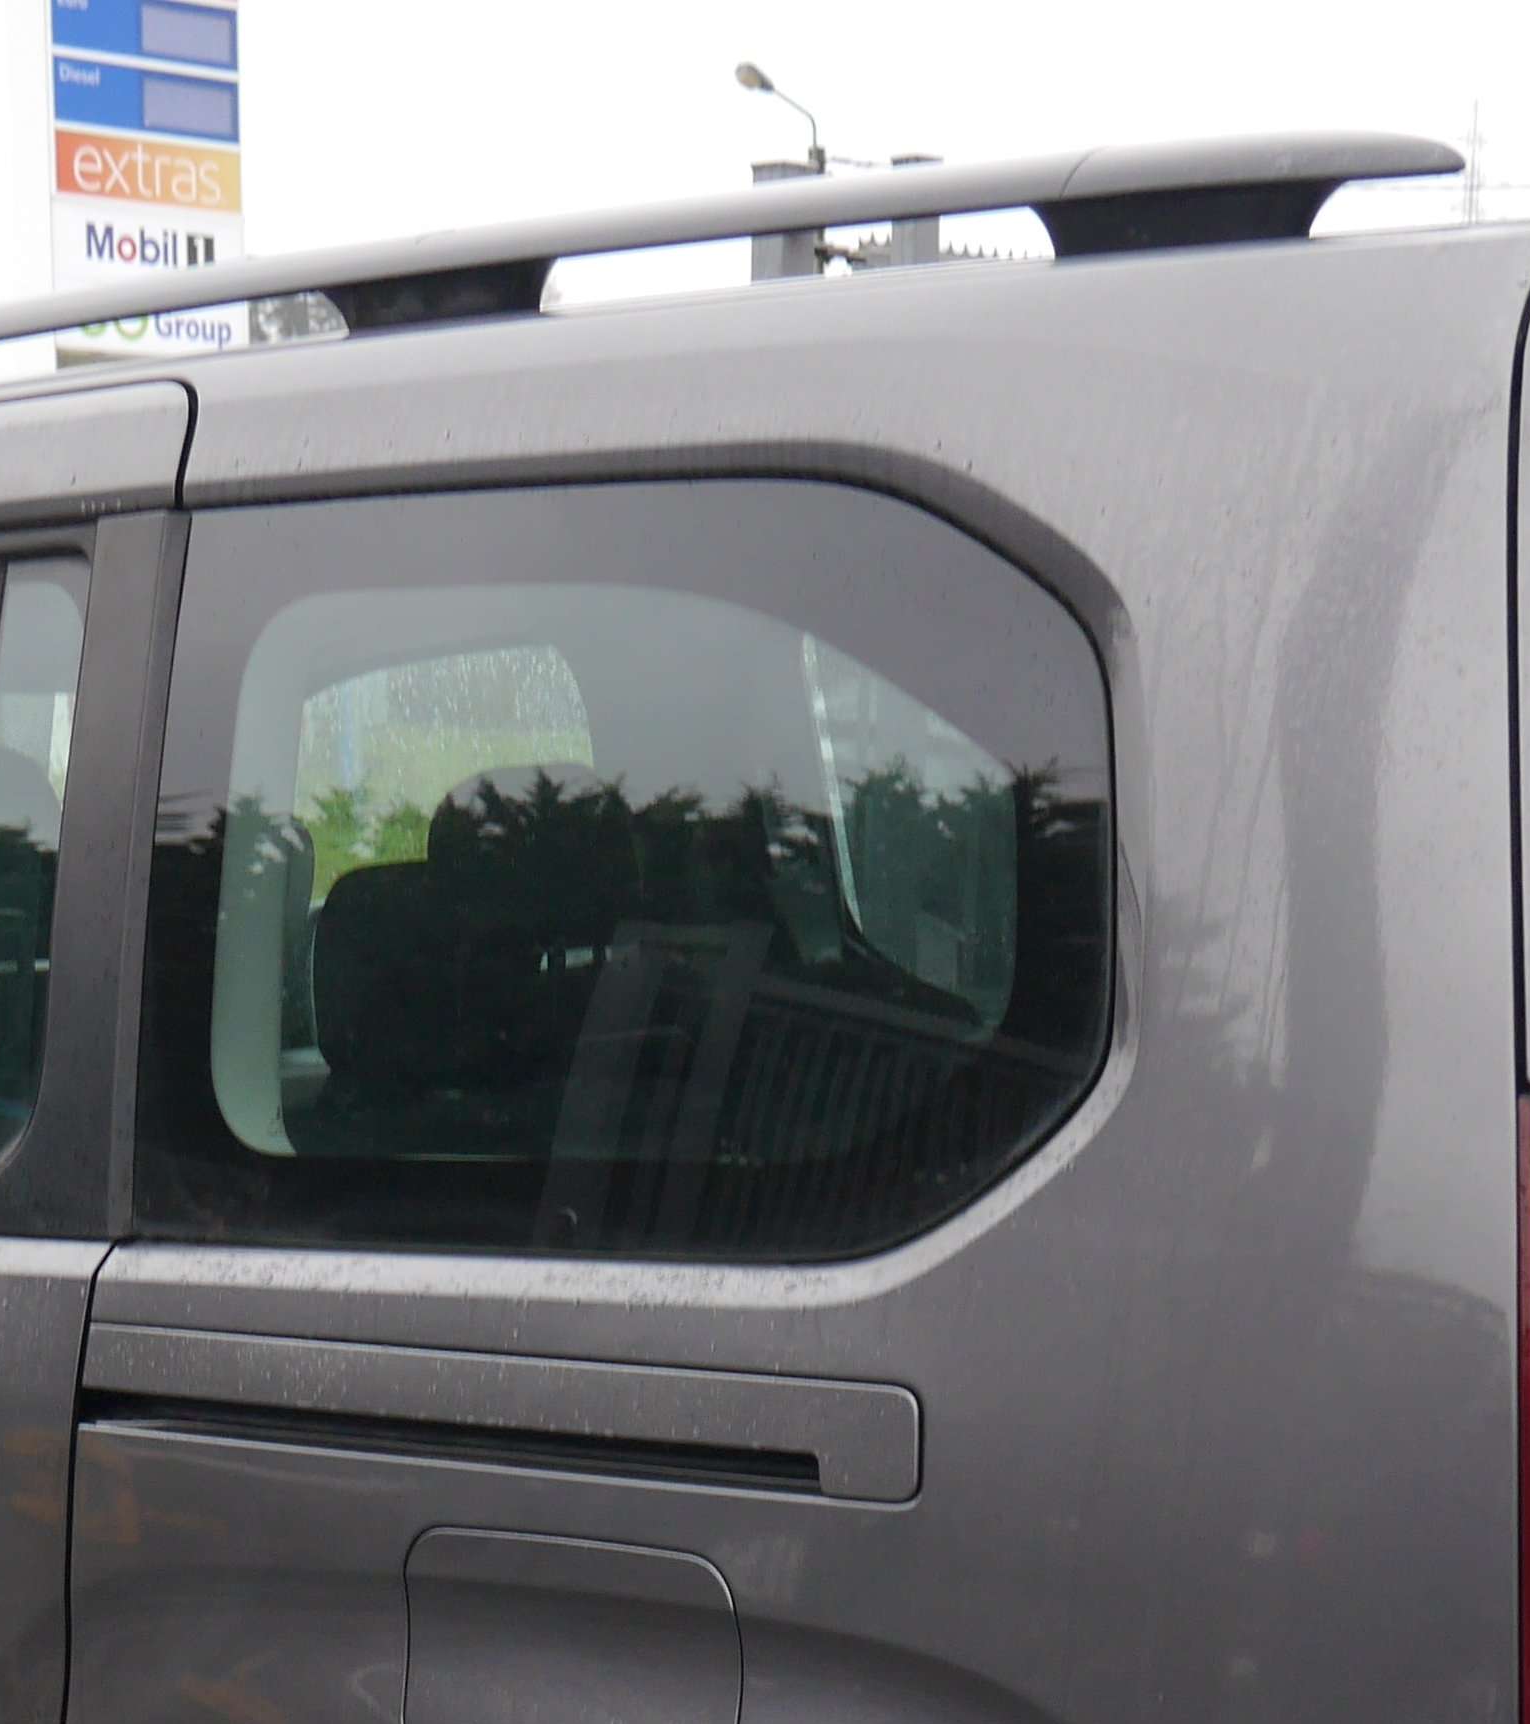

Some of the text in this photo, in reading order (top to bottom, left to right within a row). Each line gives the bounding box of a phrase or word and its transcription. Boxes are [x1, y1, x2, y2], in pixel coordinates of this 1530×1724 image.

[59, 62, 101, 87] Diesel
[73, 143, 222, 205] extras
[85, 222, 178, 266] Mobil
[154, 312, 233, 348] Group
